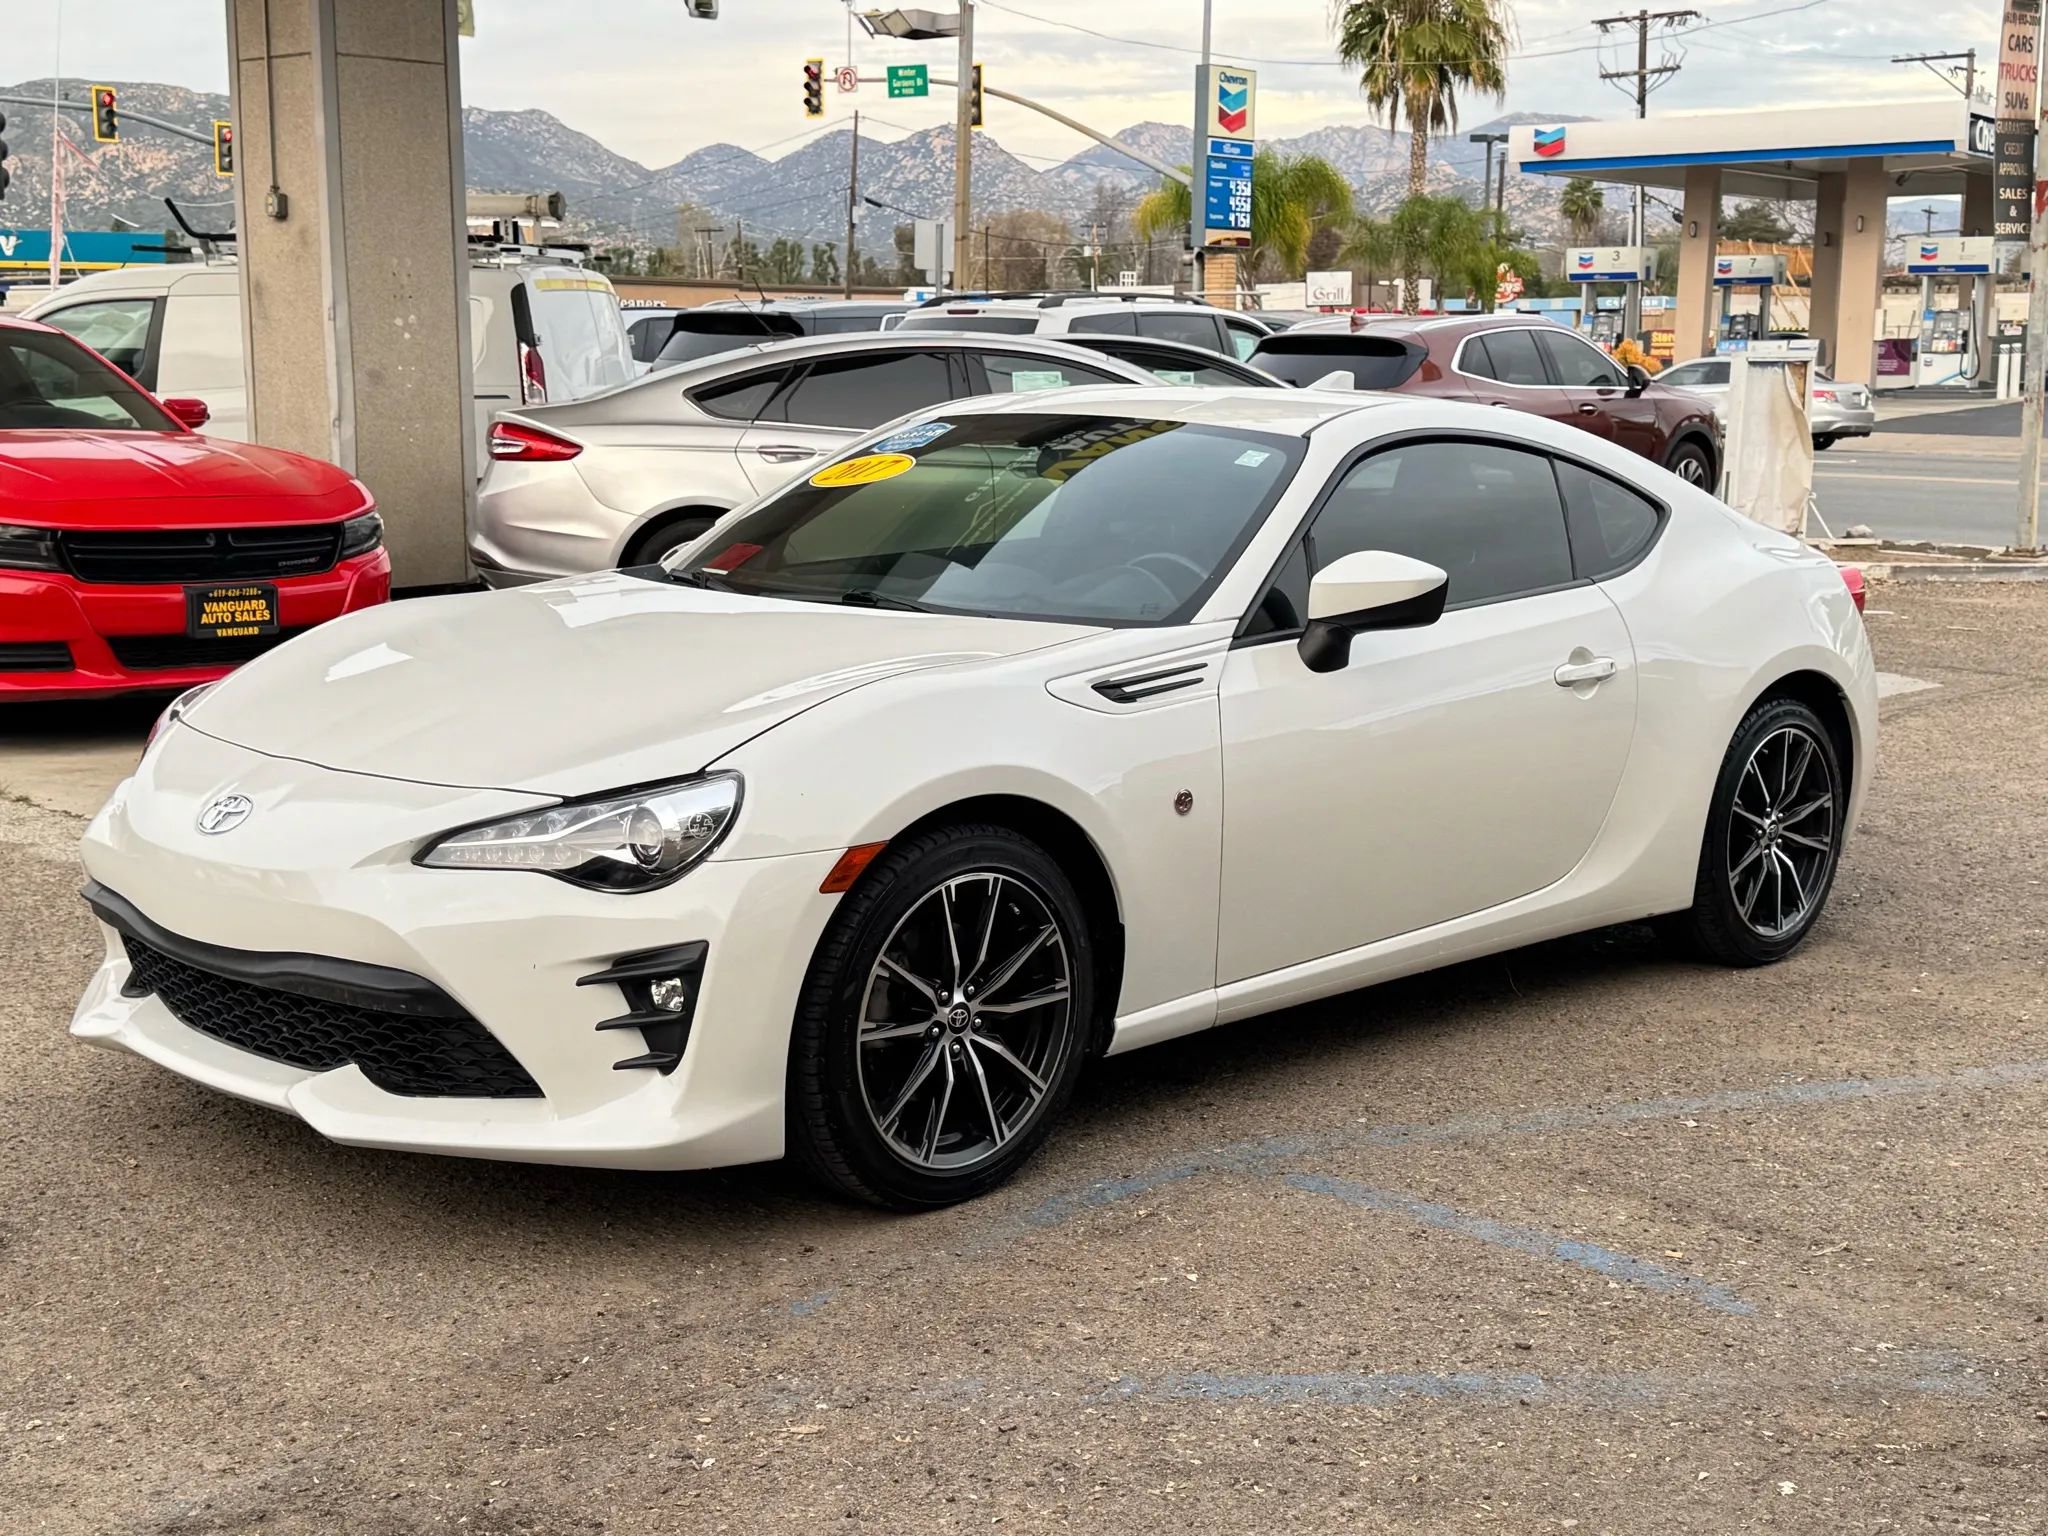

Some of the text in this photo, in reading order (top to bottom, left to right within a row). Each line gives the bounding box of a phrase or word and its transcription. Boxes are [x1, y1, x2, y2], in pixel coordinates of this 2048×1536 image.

[2008, 33, 2034, 53] CARS
[1219, 71, 1247, 86] Chevron
[2000, 62, 2037, 82] TRUCKS
[2004, 91, 2029, 111] SUVs
[1999, 187, 2028, 200] SALES
[2009, 205, 2018, 217] &
[1612, 250, 1621, 261] 3
[1749, 258, 1757, 267] 7
[1313, 287, 1344, 300] Grill
[816, 459, 906, 482] 2017
[204, 600, 267, 613] VANGUARD
[201, 609, 270, 624] AUTO SALES
[217, 626, 260, 637] VANGUARD
